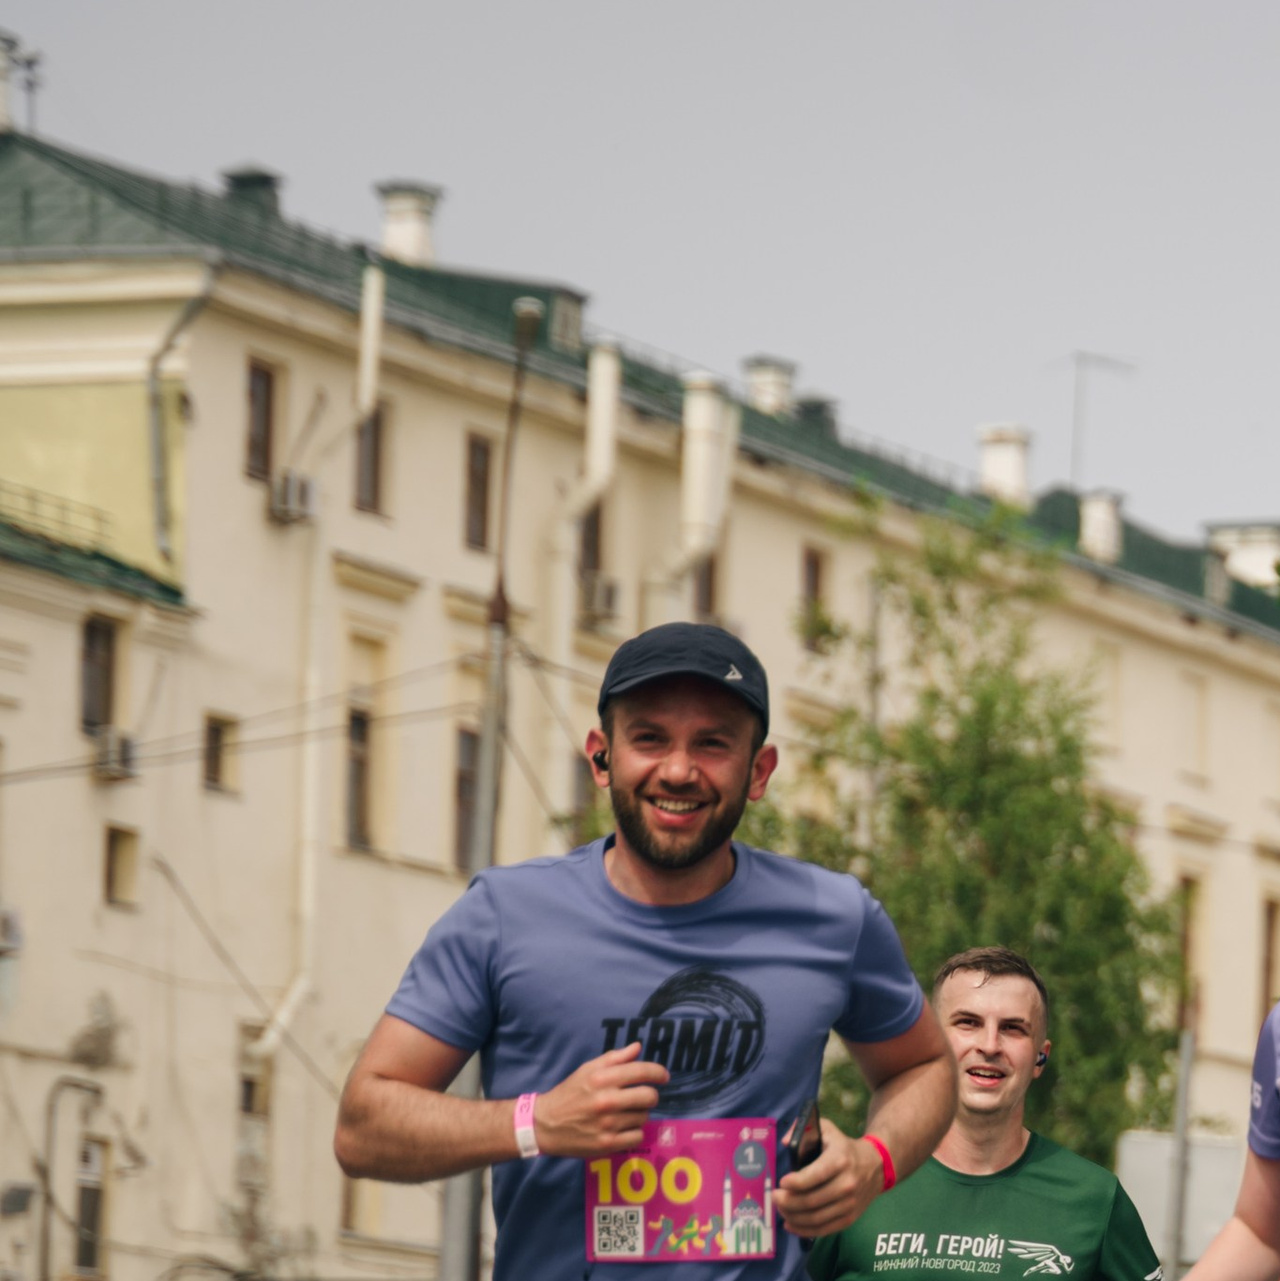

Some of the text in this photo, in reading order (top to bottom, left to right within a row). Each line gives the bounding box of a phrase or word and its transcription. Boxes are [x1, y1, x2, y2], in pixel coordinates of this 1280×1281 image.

[743, 1146, 754, 1162] 1
[590, 1156, 703, 1205] 100
[875, 1233, 1005, 1259] БЕГИ, ГЕРОЙ!
[873, 1256, 1001, 1274] НИЖНИЙ НОВГОРОД 2023
